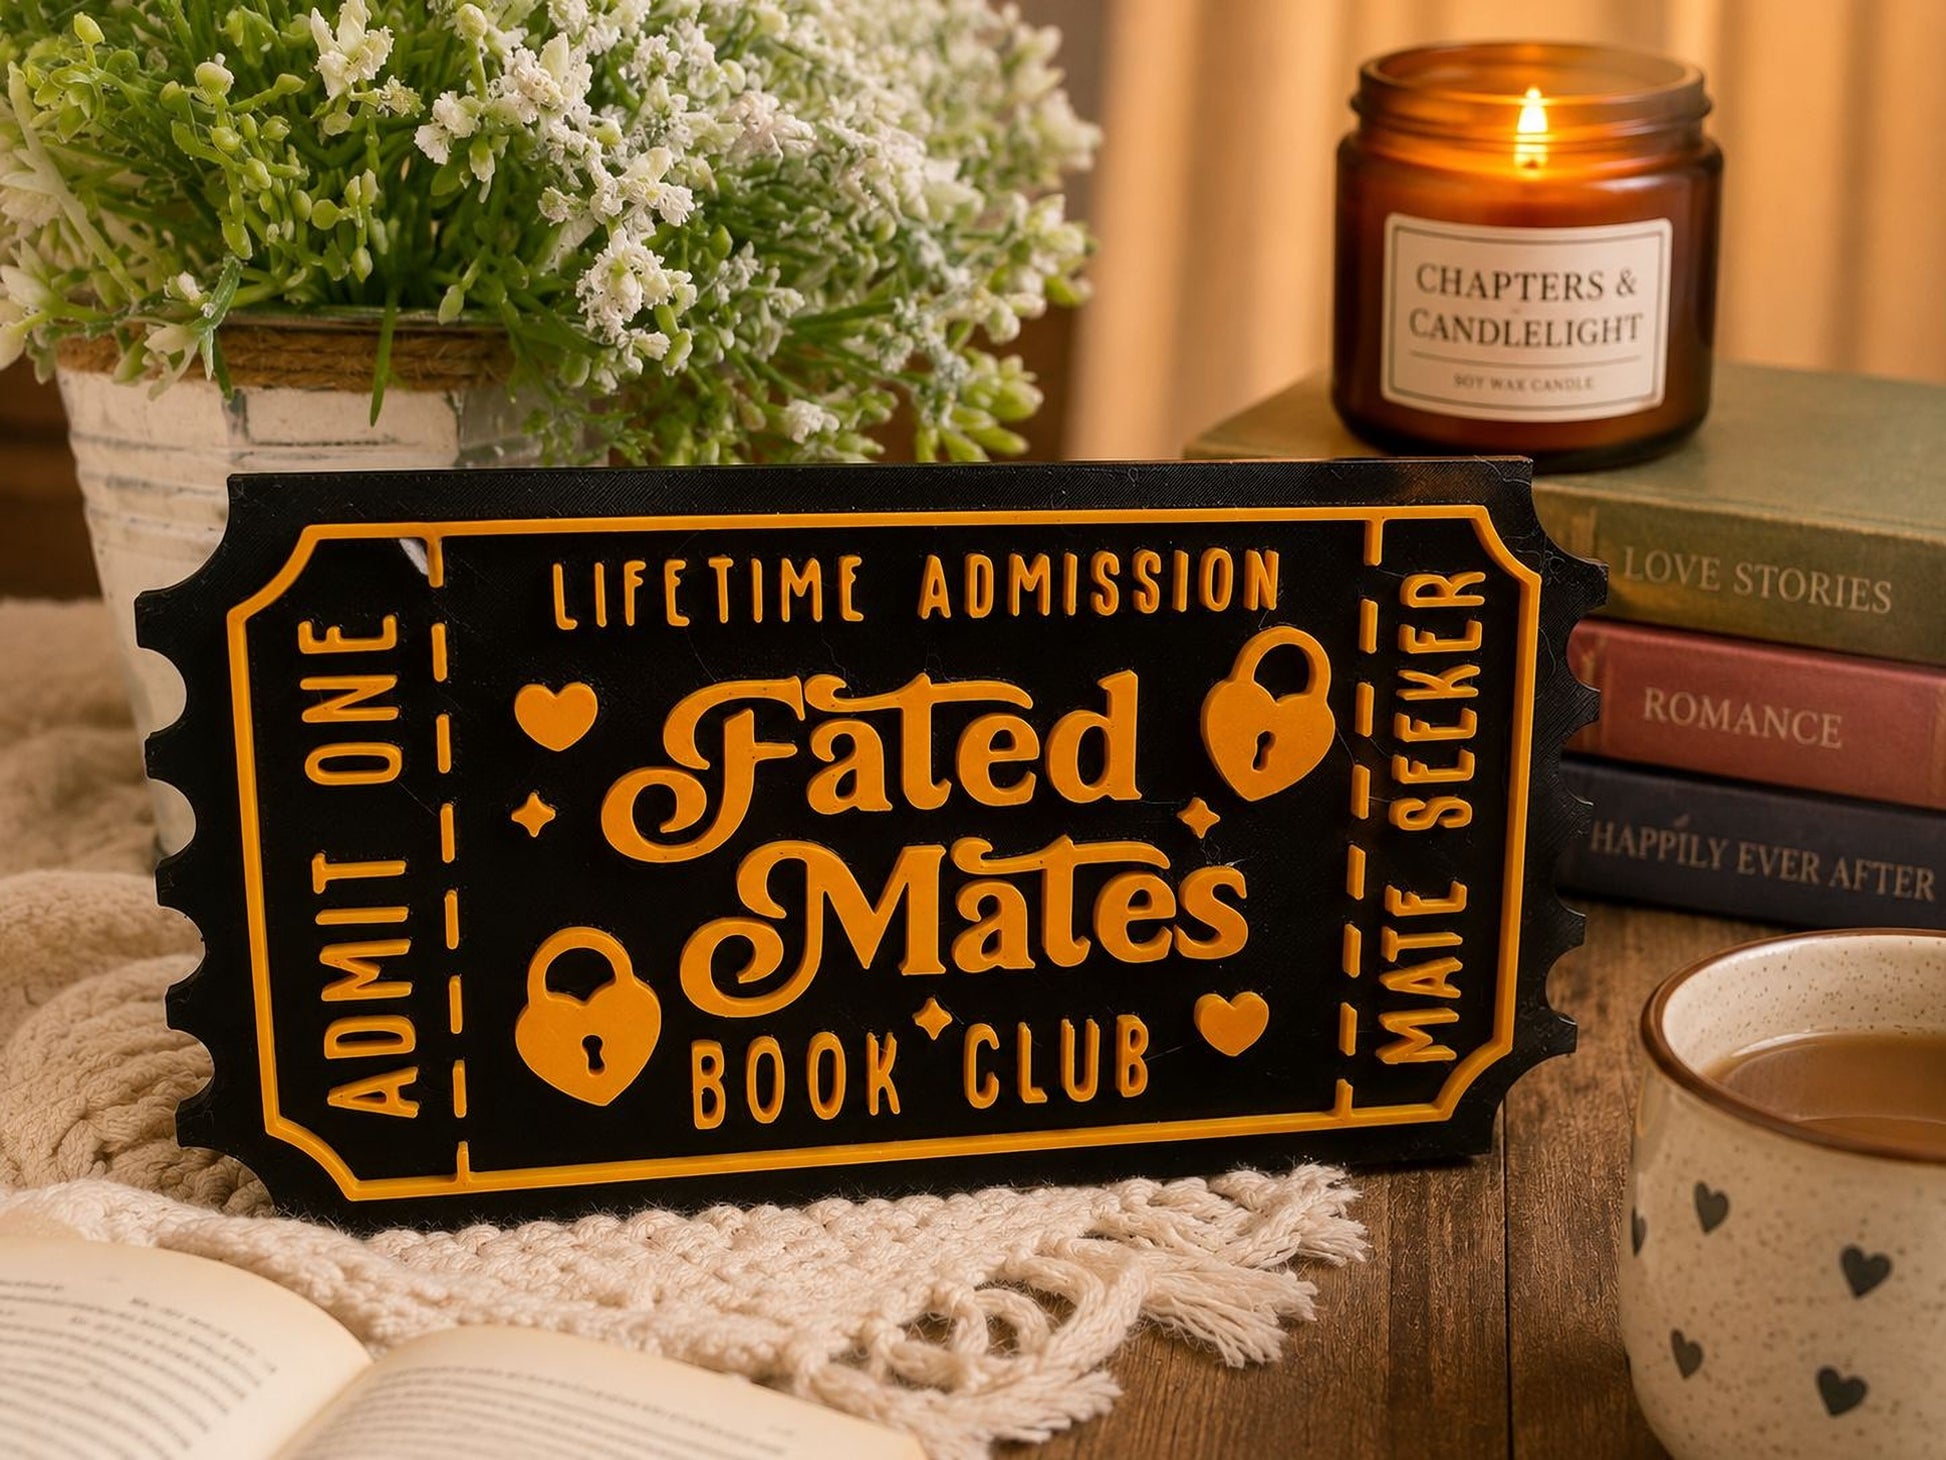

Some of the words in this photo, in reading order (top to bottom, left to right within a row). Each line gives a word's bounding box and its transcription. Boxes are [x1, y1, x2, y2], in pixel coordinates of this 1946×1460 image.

[1408, 308, 1643, 348] CANDLELIGHT
[1416, 262, 1604, 301] CHAPTERS
[1616, 267, 1638, 297] &
[1490, 375, 1525, 391] WAX
[1530, 376, 1593, 392] CANDLE
[552, 555, 864, 631] LIFETIME
[917, 547, 1280, 620] ADMISSION
[1624, 546, 1721, 592] LOVE
[1733, 561, 1893, 615] STORIES
[297, 612, 404, 787] ONE
[1390, 570, 1487, 831] SEEKER
[1643, 687, 1843, 749] ROMANCE
[600, 670, 1141, 865] Fated
[1737, 841, 1820, 886] EVER
[1828, 856, 1937, 902] AFTER
[679, 834, 1250, 1019] Mates
[1375, 879, 1469, 1066] MATE
[310, 850, 420, 1120] ADMIT
[690, 1030, 902, 1131] BOOK
[963, 1013, 1151, 1110] CLUB
